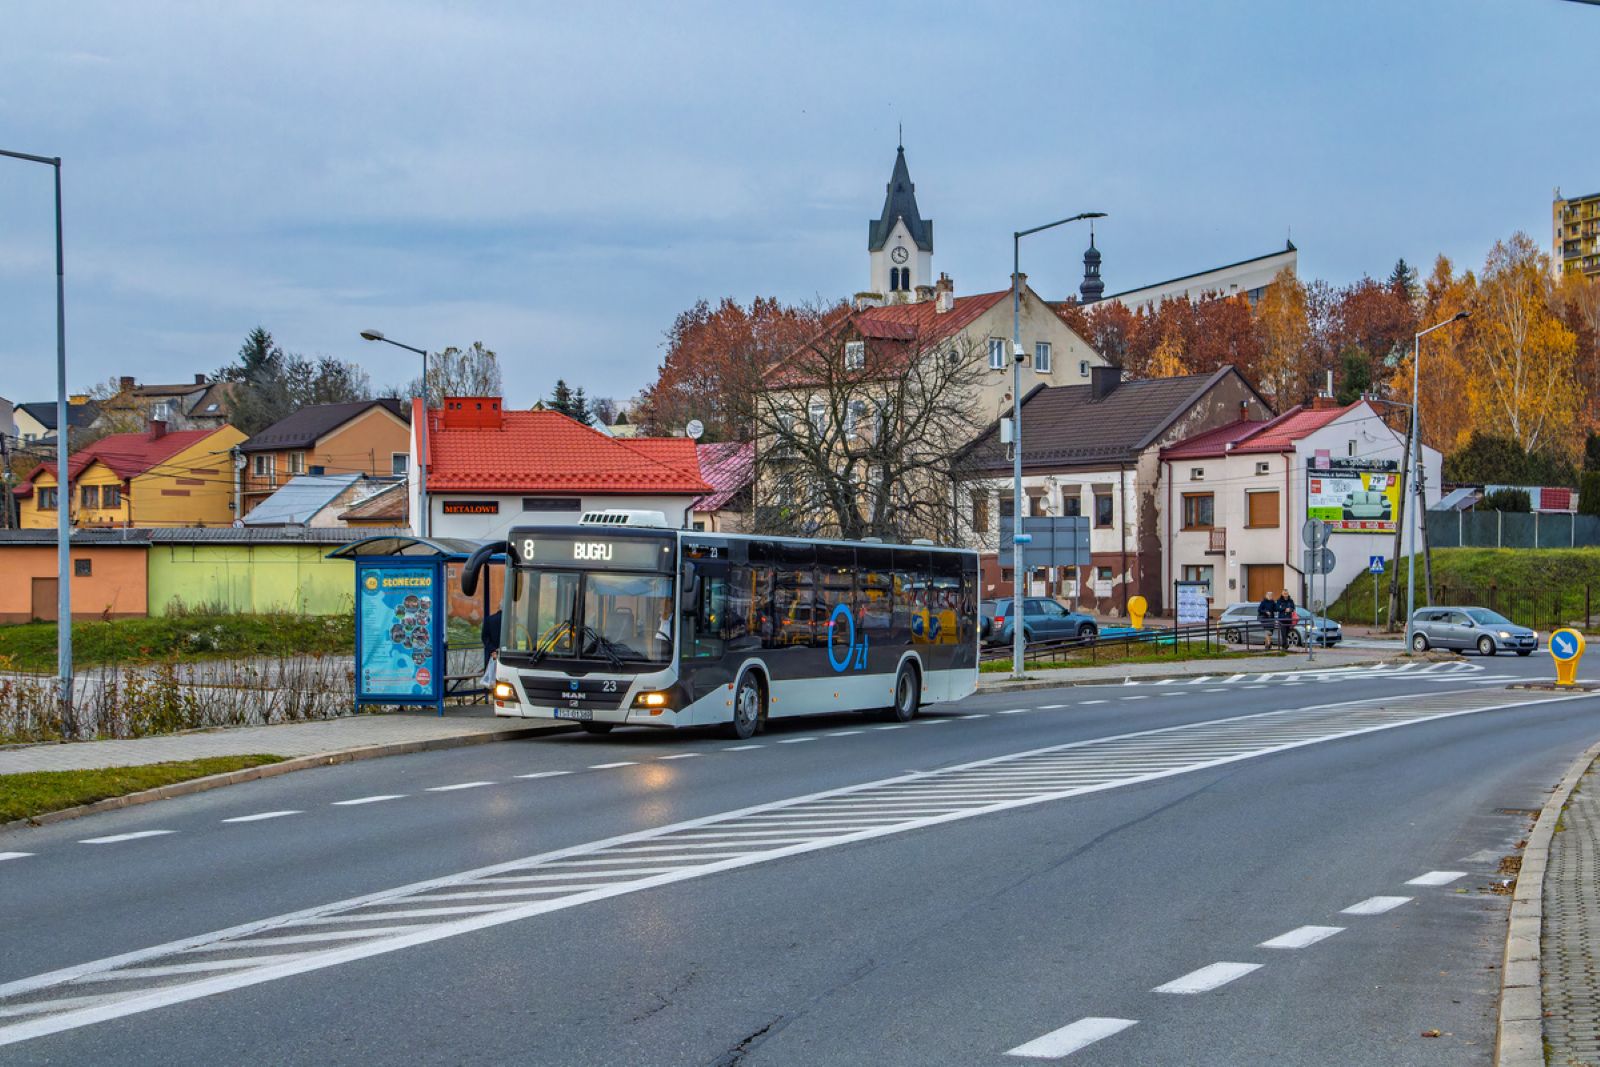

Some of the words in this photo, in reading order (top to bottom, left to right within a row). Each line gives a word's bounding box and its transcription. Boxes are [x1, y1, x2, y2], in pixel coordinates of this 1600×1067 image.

[445, 504, 497, 513] METALOWE
[524, 540, 534, 560] 8
[573, 542, 613, 560] BUGAJ
[602, 680, 617, 692] 23
